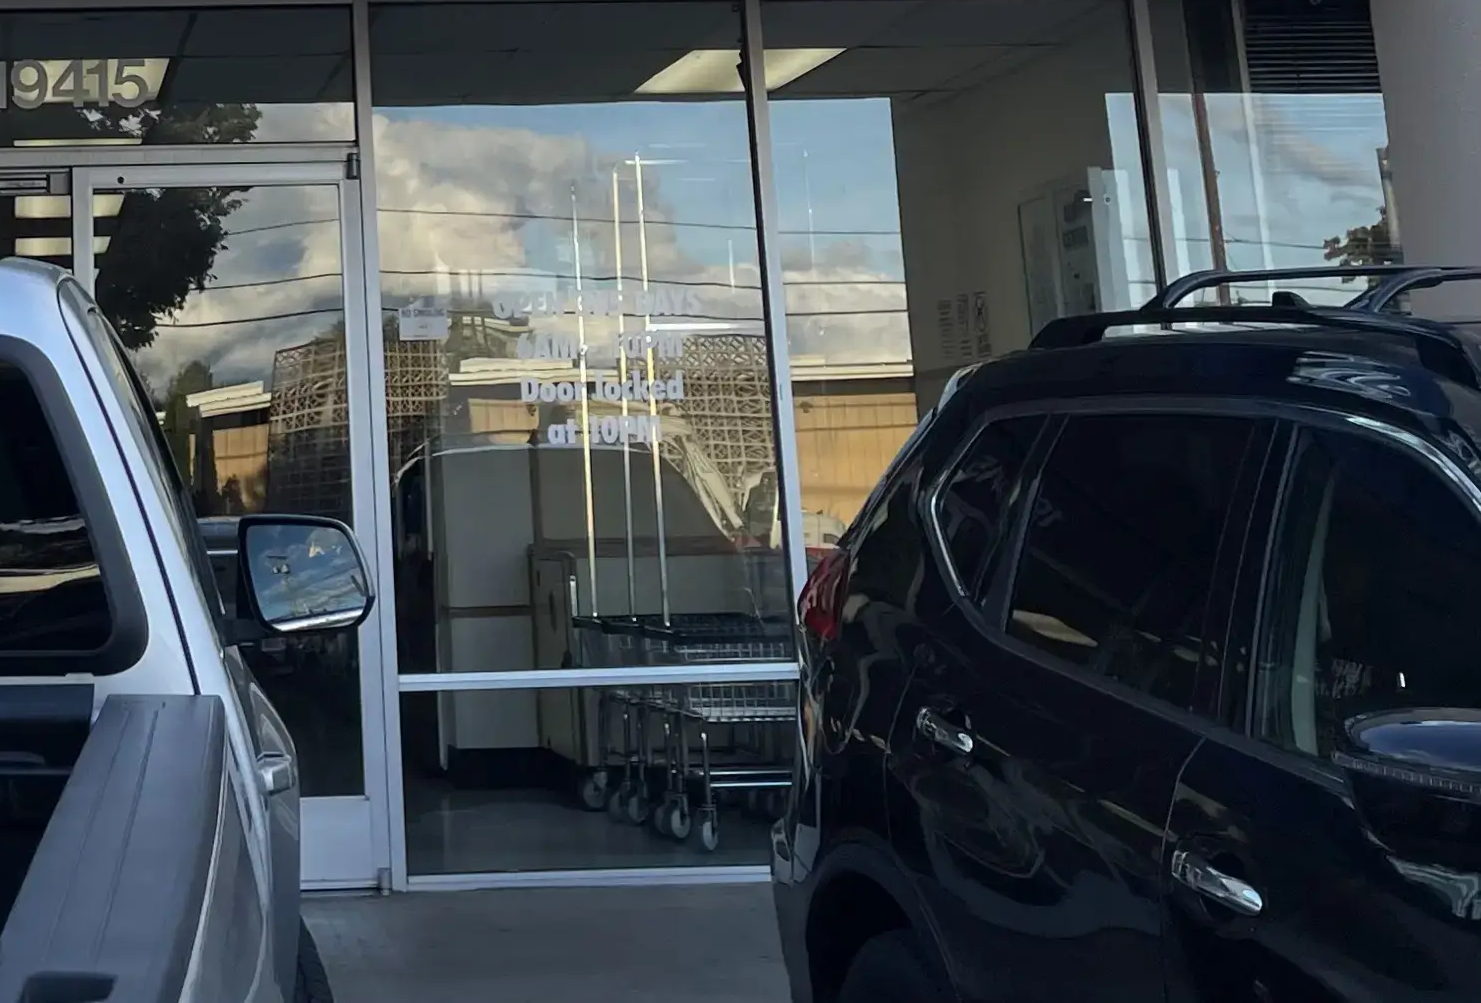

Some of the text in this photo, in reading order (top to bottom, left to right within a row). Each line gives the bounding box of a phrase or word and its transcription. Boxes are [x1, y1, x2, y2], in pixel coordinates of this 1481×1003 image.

[521, 369, 685, 403] Door locked
[547, 414, 662, 445] at 10PM
